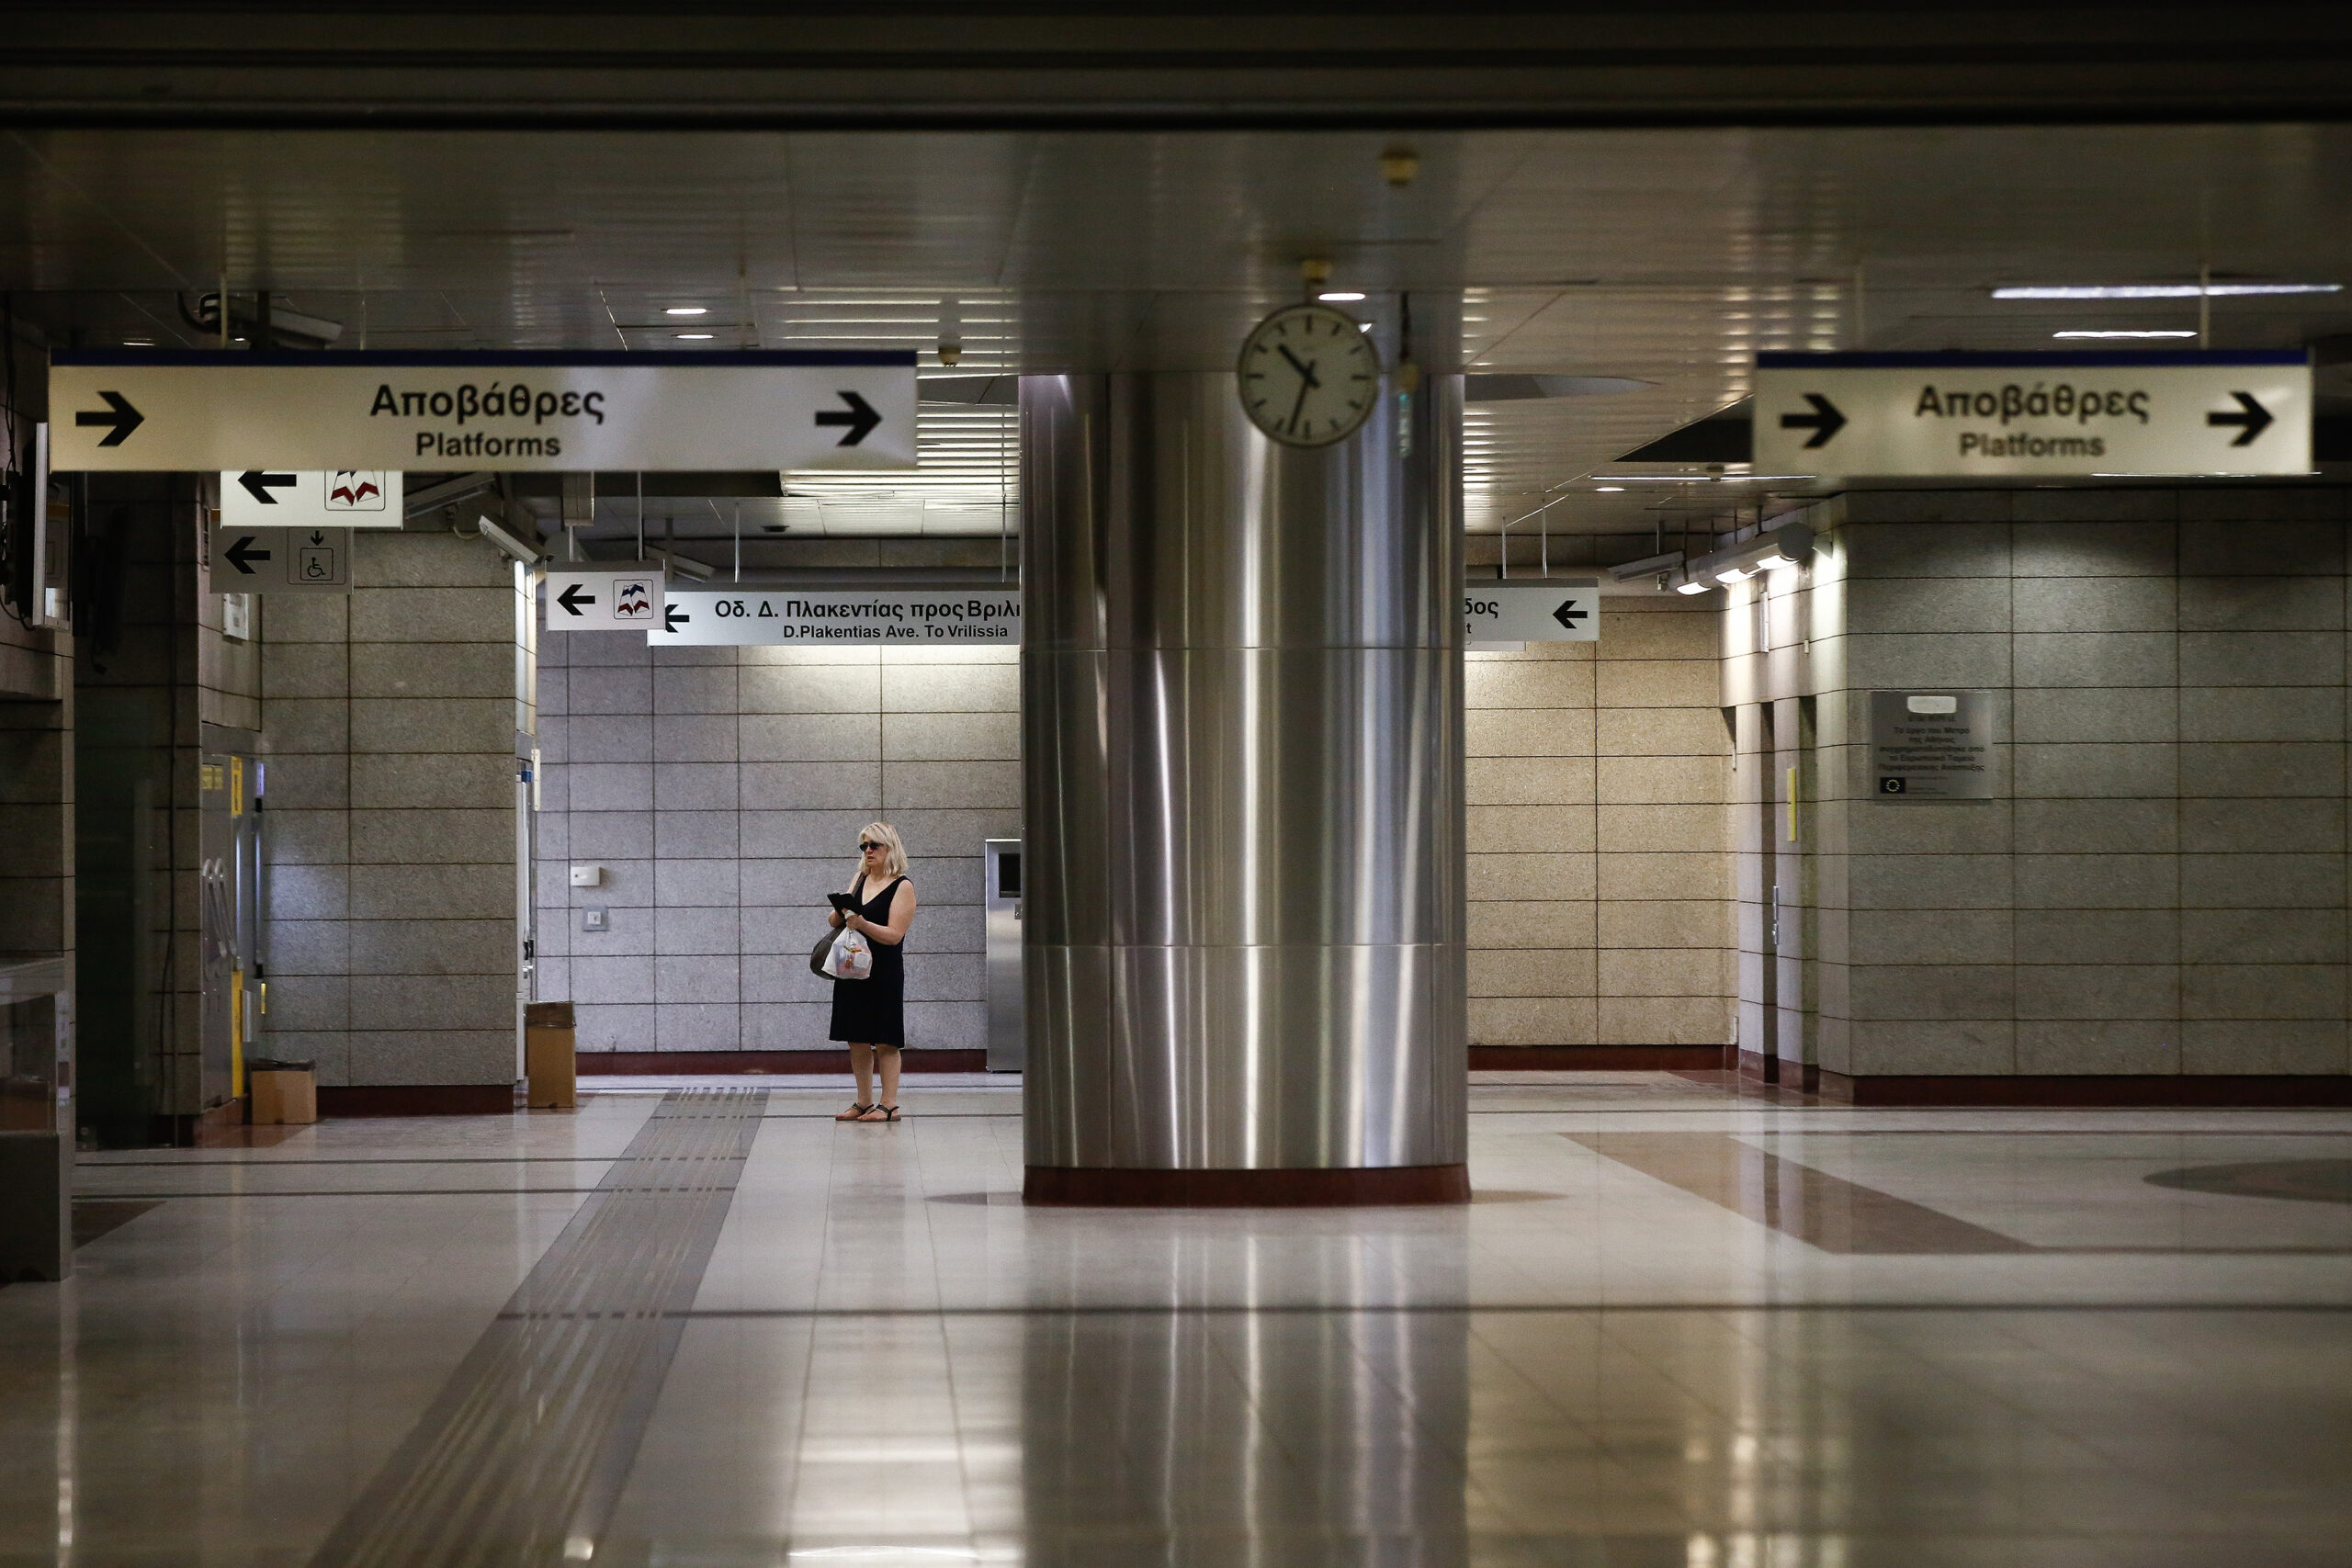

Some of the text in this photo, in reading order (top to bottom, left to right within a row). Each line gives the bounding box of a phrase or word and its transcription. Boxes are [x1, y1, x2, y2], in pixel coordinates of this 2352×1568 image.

[369, 382, 605, 425] Αποβάθρες
[1915, 382, 2151, 425] Αποβάθρες
[415, 432, 561, 457] Platforms
[1959, 432, 2107, 457] Platforms
[715, 600, 751, 618] Οδ.
[758, 601, 779, 618] Δ.
[786, 599, 904, 622] Πλακεντίας
[910, 604, 964, 622] προς
[1464, 597, 1499, 619] δος
[885, 625, 920, 638] Ave.
[924, 625, 944, 637] To
[947, 625, 1009, 637] Vrilissia
